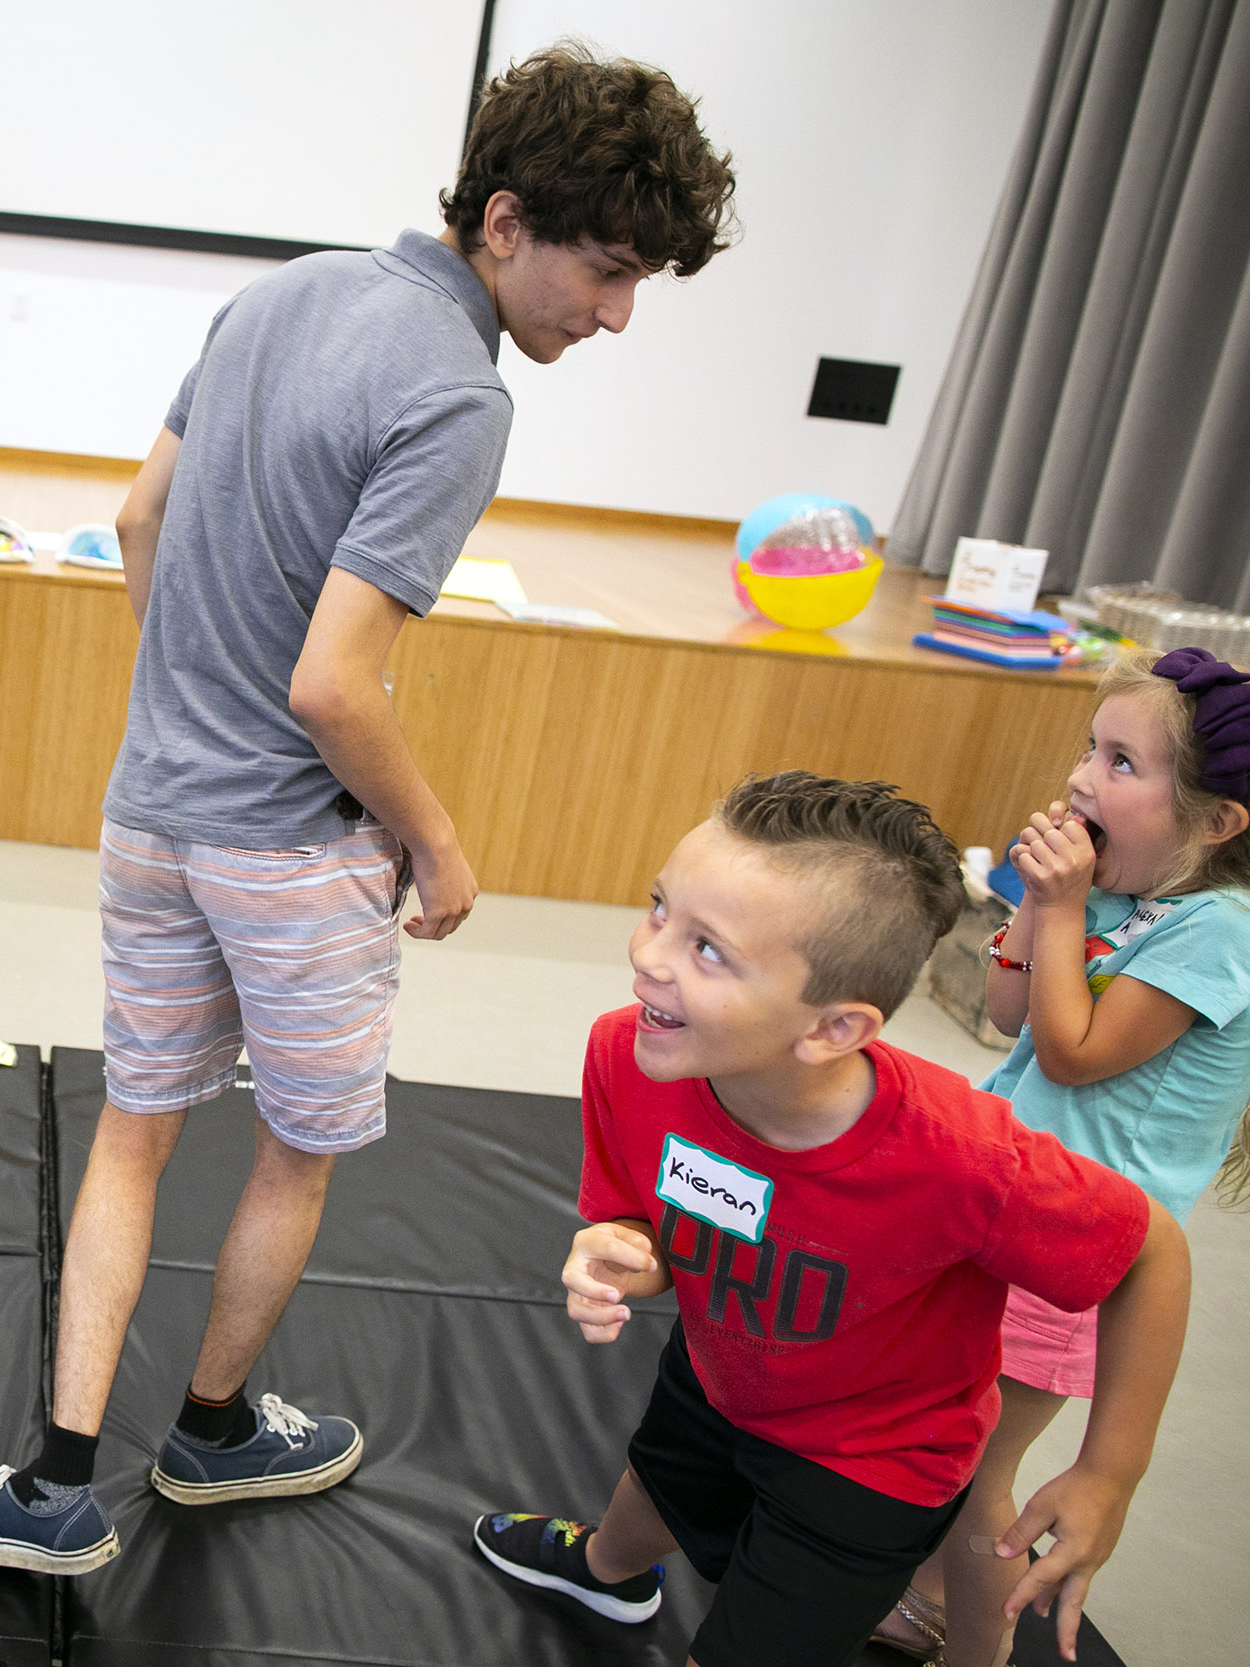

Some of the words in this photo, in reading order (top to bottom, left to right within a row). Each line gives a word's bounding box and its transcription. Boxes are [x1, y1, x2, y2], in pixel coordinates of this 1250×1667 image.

[669, 1157, 757, 1216] Kieran
[766, 1222, 807, 1246] MUCH
[709, 1324, 786, 1354] EVERYTHING
